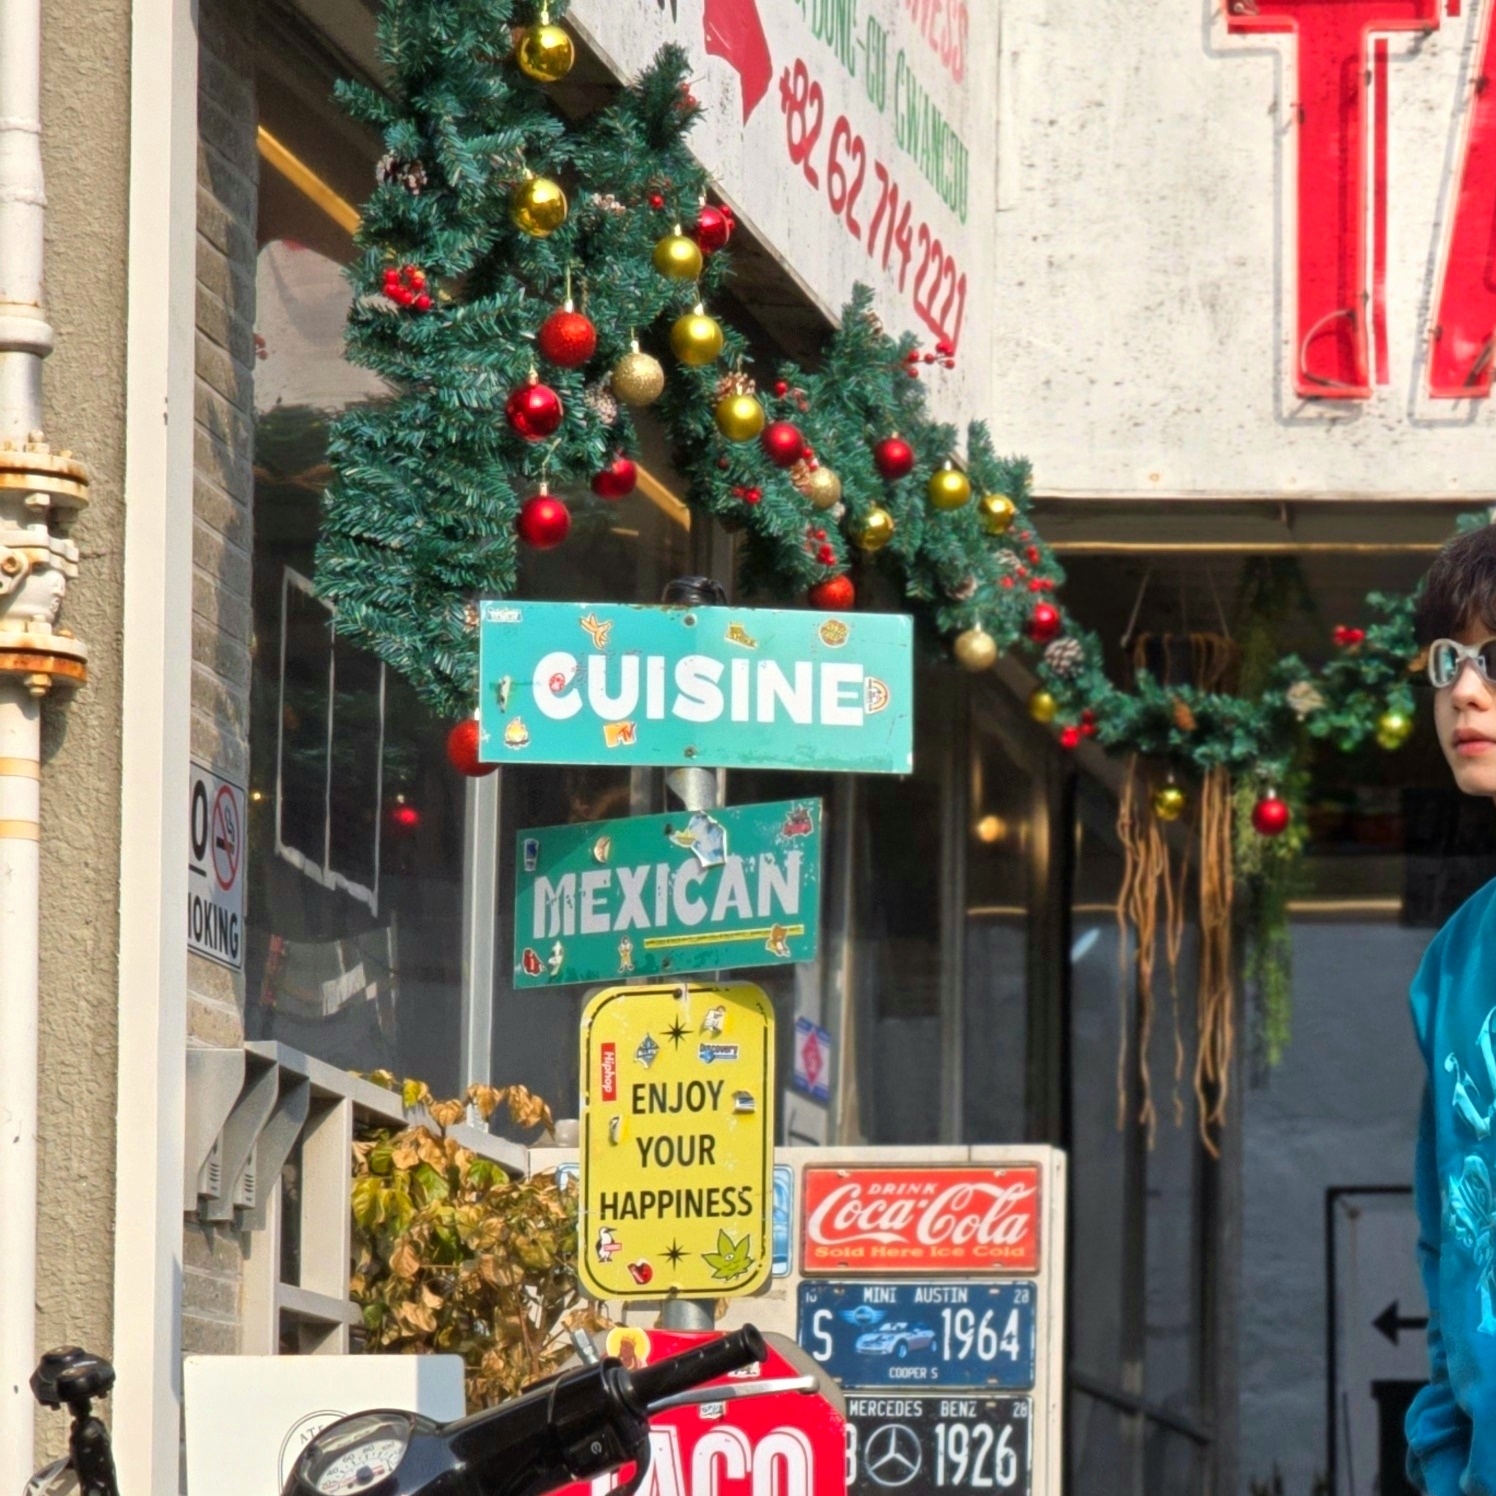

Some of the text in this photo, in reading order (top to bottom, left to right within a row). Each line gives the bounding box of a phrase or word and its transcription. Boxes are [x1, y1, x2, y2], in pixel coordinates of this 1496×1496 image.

[827, 115, 866, 241] 62
[867, 159, 912, 293] 714
[533, 652, 863, 726] CUISINE
[533, 850, 800, 939] MEXICAN
[602, 1051, 615, 1093] Hiphop
[632, 1080, 724, 1114] ENJOY
[636, 1134, 716, 1168] YOUR
[600, 1186, 753, 1220] HAPPINESS
[867, 1183, 938, 1195] DRINK
[815, 1246, 1025, 1258] Sold Here Ice Cold
[864, 1287, 897, 1303] MINI
[914, 1287, 968, 1303] AUSTIN
[812, 1308, 1019, 1361] S 1964
[889, 1367, 938, 1379] COOPER S
[849, 1401, 922, 1417] MERCEDES
[940, 1401, 977, 1417] BENZ
[935, 1423, 1017, 1487] 1926
